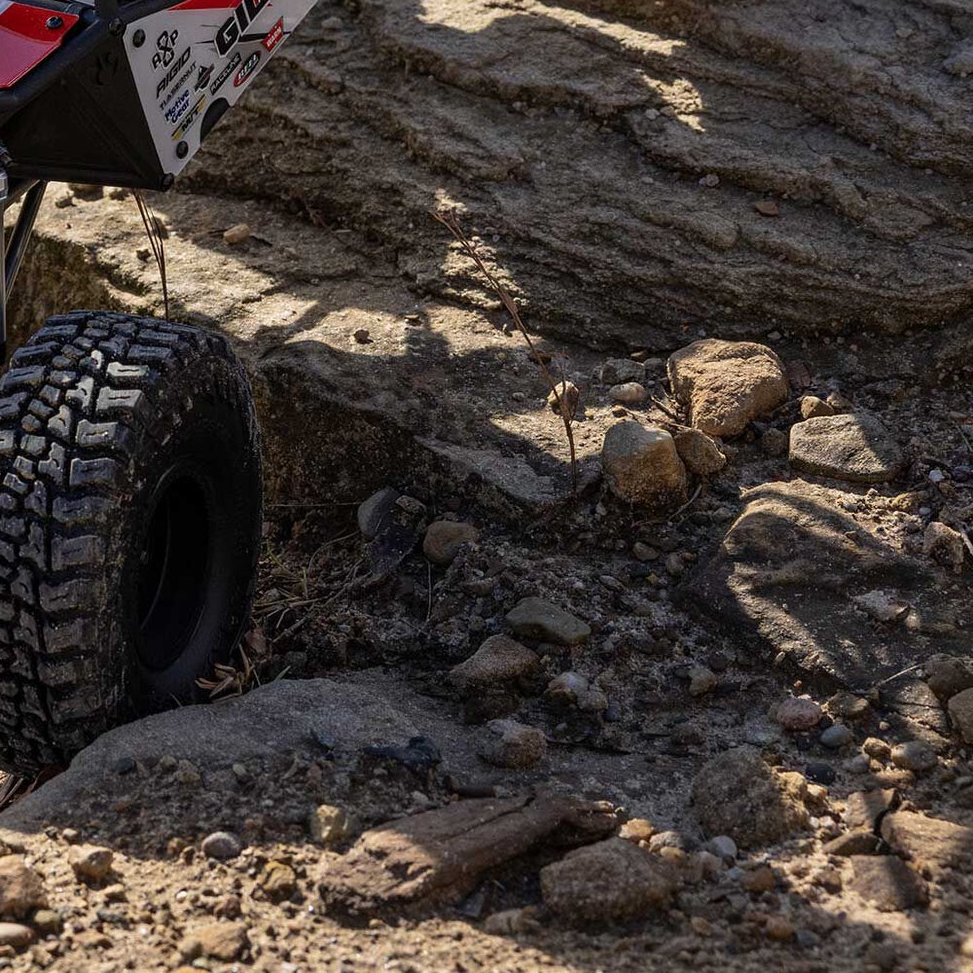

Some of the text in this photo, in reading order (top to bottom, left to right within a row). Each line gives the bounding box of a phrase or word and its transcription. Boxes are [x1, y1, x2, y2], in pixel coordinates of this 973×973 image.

[156, 46, 191, 99] RIGID
[164, 89, 190, 121] Motive
[171, 98, 190, 124] Gear
